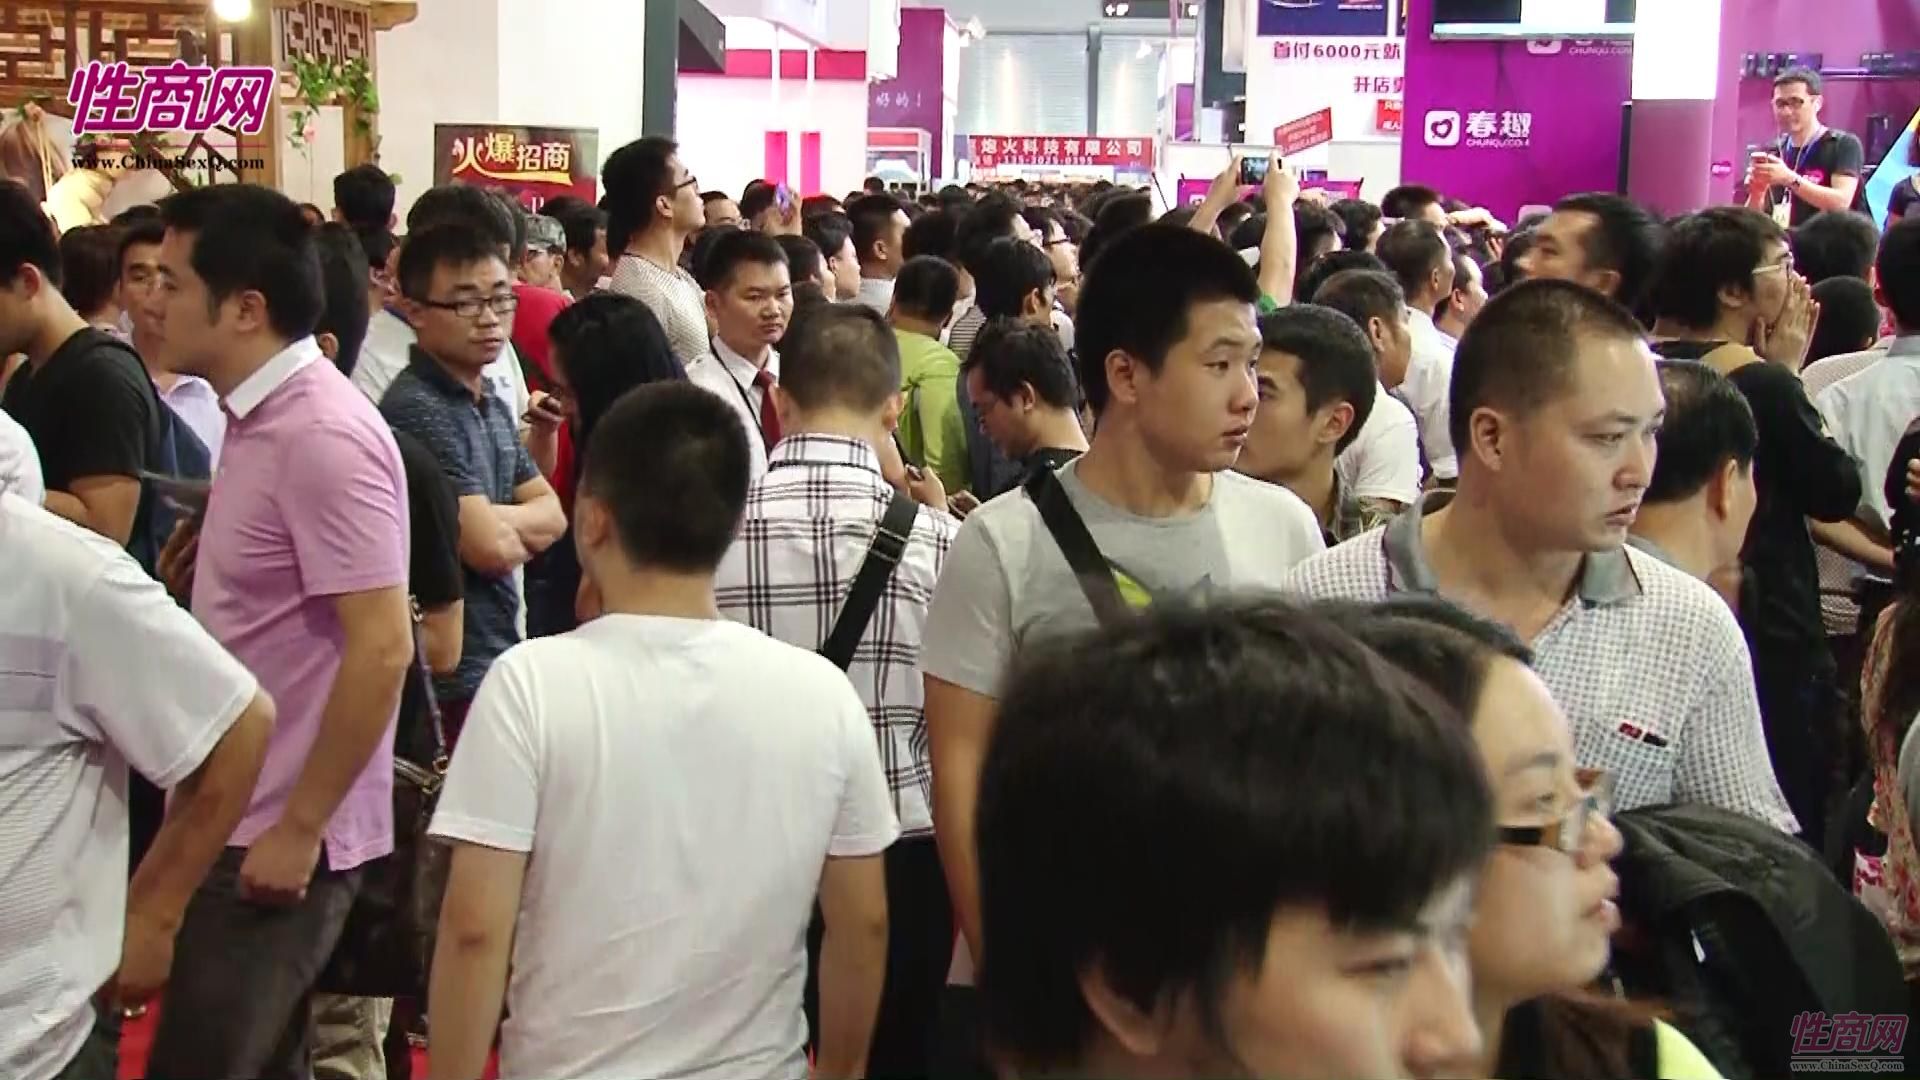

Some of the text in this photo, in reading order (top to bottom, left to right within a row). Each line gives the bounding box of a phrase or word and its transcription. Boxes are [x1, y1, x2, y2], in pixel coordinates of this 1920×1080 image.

[1466, 110, 1532, 138] 春趣
[451, 132, 573, 180] 火爆招商
